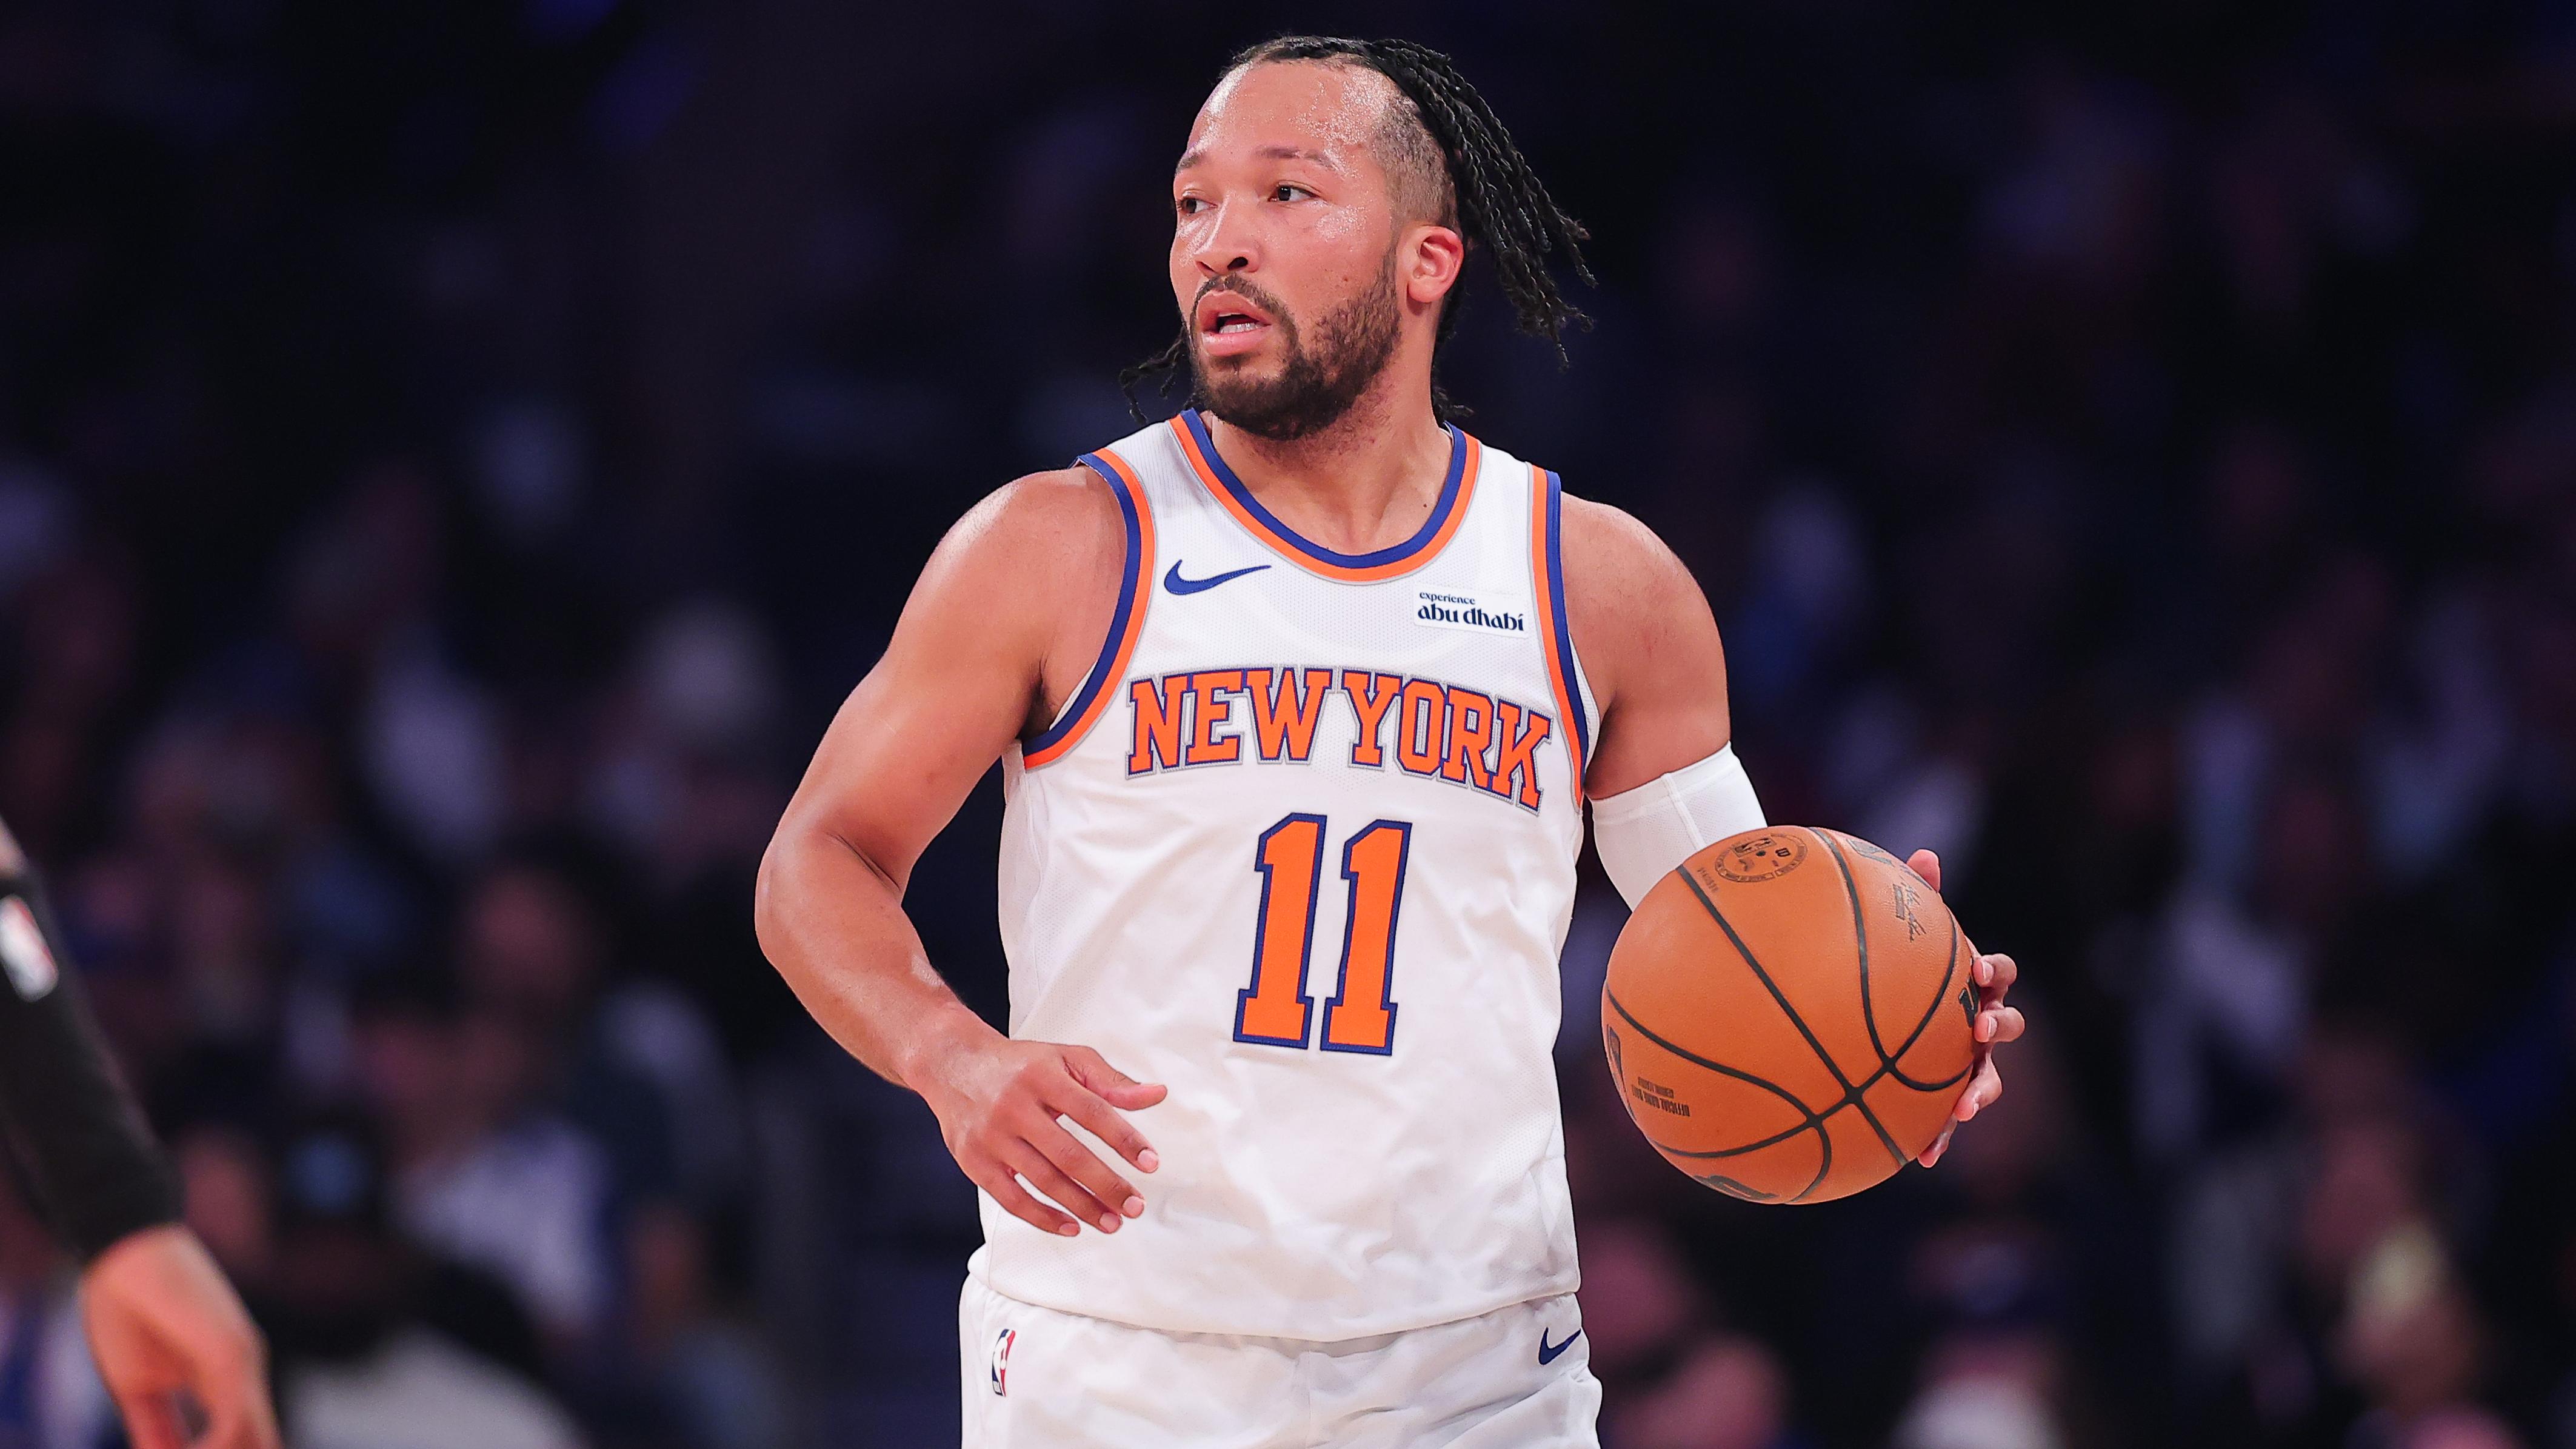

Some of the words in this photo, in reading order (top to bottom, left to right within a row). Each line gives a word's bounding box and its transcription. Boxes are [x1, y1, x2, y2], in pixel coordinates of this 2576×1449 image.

[1418, 604, 1459, 623] abu
[1420, 591, 1475, 605] experience
[1126, 665, 1333, 779] NEW
[1338, 667, 1554, 816] YORK
[1233, 812, 1413, 1056] 11
